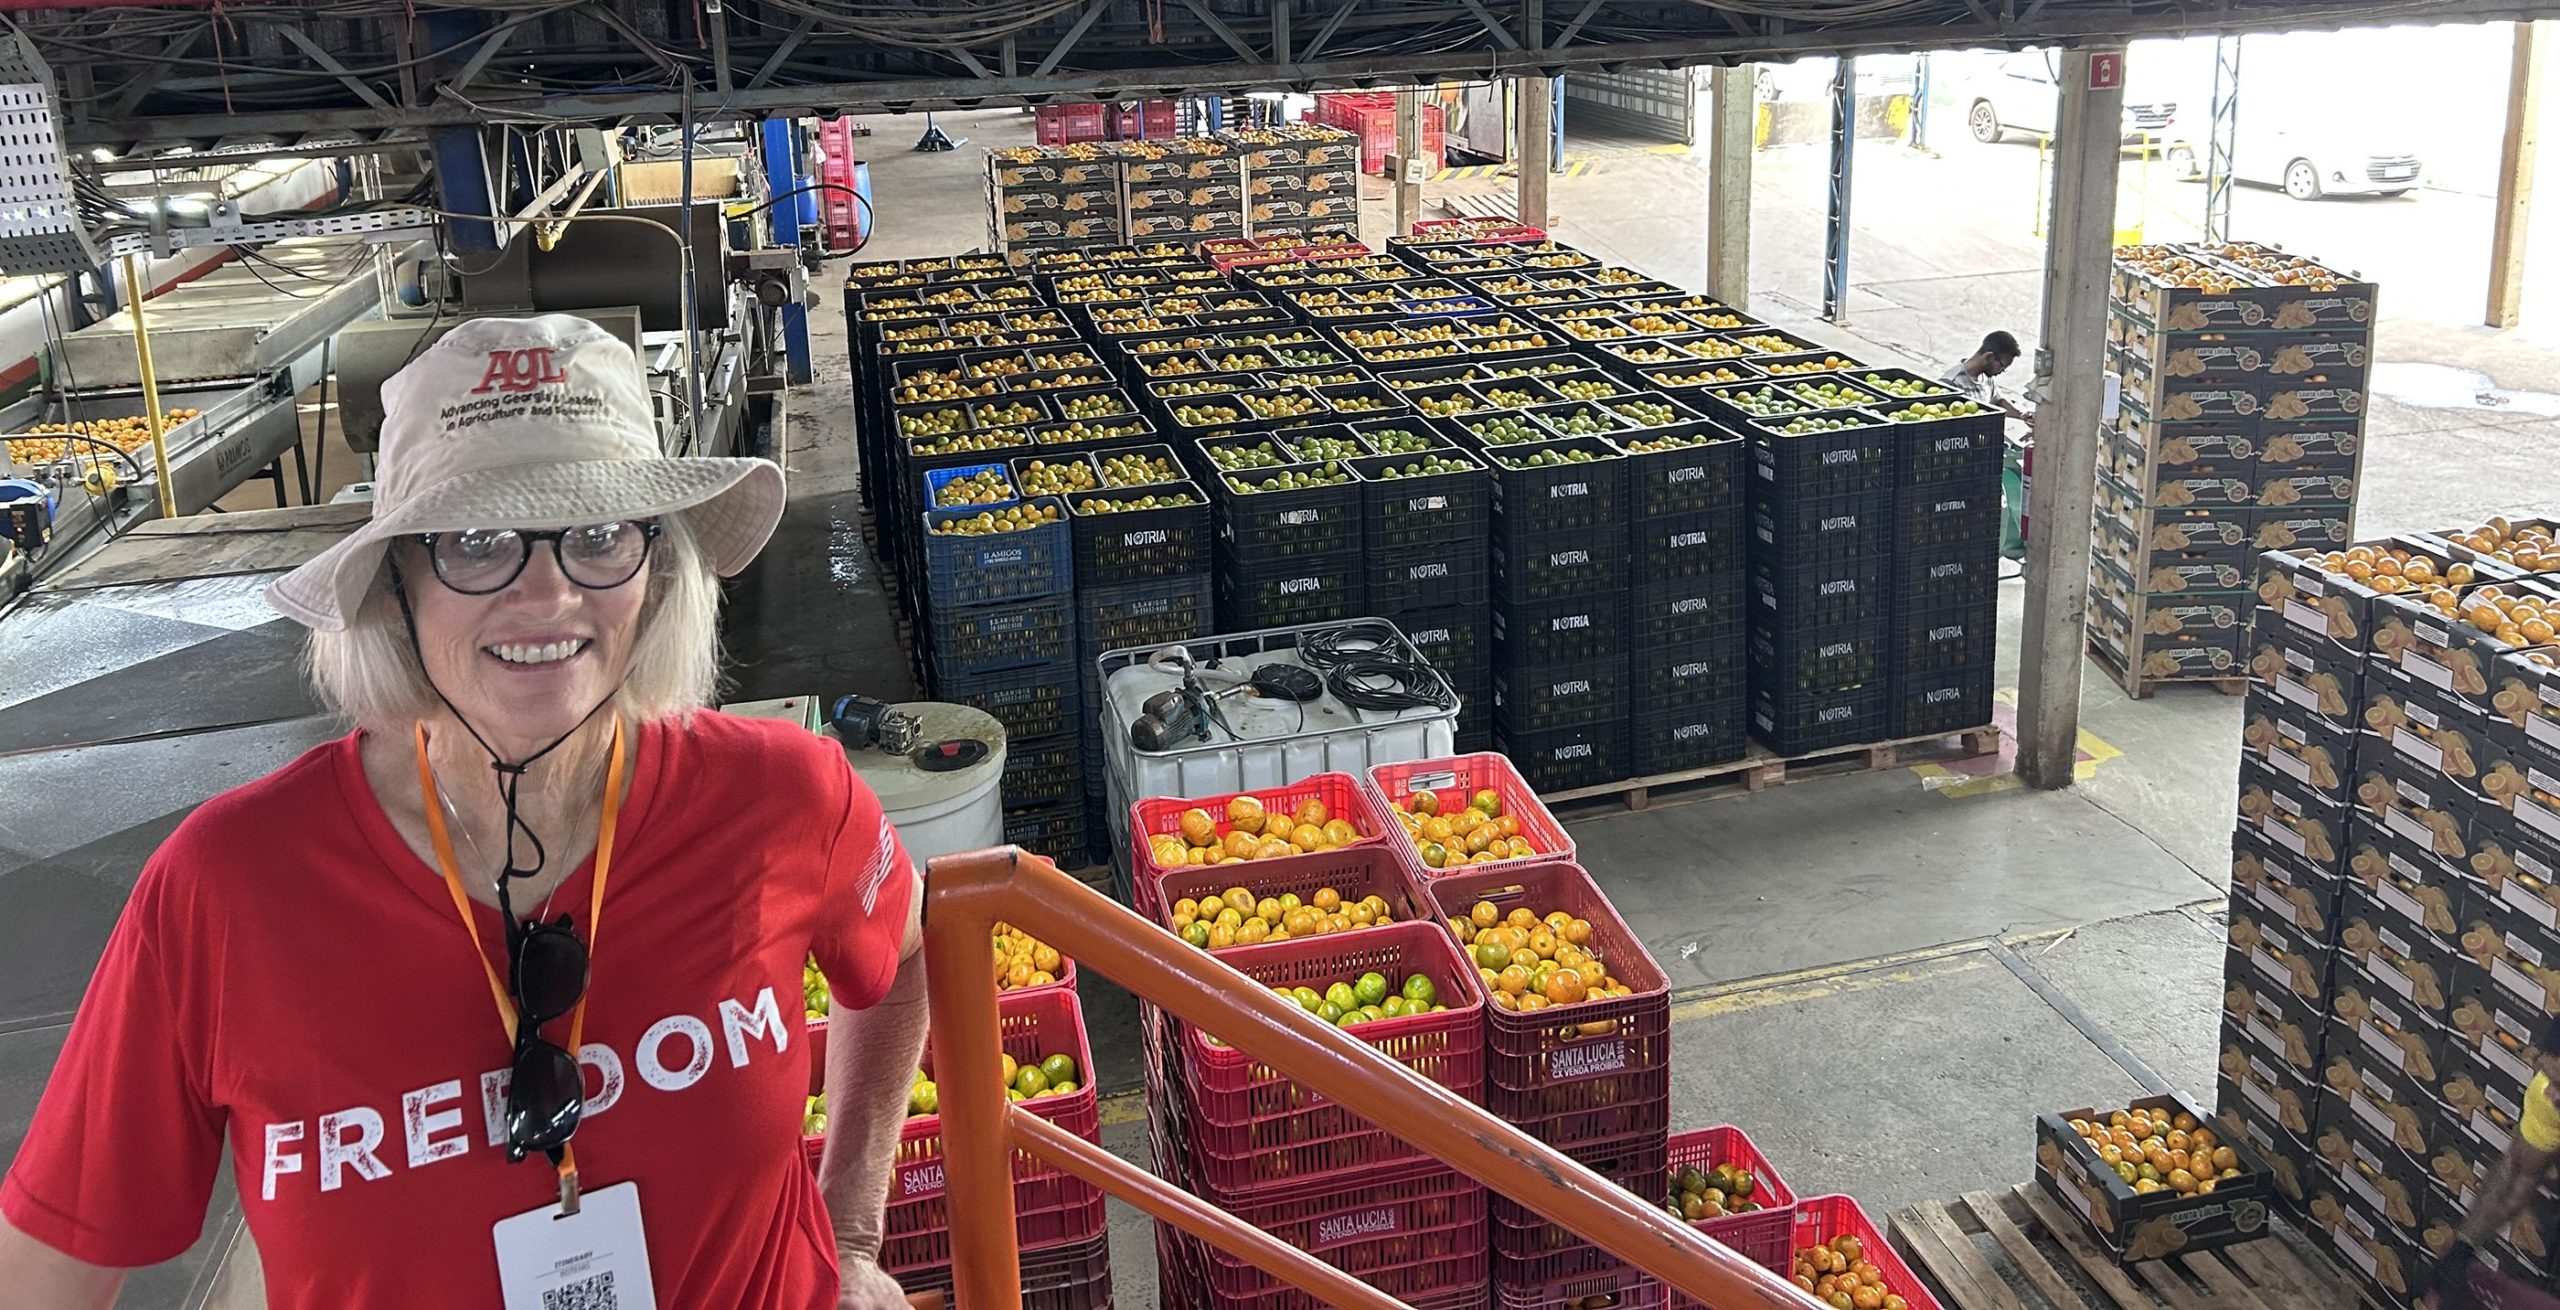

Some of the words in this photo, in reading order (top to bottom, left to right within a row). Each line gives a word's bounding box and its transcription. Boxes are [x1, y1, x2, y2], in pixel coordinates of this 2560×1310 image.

[440, 398, 499, 420] Advancing
[446, 420, 455, 431] in
[458, 407, 525, 428] Agriculture
[530, 406, 552, 416] and
[1935, 437, 1969, 452] NOTRIA
[1822, 449, 1857, 465] NOTRIA
[1668, 466, 1704, 483] NOTRIA
[1551, 482, 1588, 498] NOTRIA
[1935, 500, 1966, 511] NOTRIA
[1280, 509, 1318, 524] NTRIA
[1821, 515, 1855, 531] NOTRIA
[1125, 530, 1166, 546] NOTRIA
[1671, 532, 1706, 548] NOTRIA
[990, 549, 1022, 558] AMIGOS
[1551, 550, 1588, 566] NOTRIA
[1410, 563, 1448, 579] NOTRIA
[1930, 563, 1963, 579] NOTRIA
[1281, 576, 1320, 594] NOTRIA
[1820, 579, 1855, 595] NOTRIA
[1672, 598, 1707, 614] NOTRIA
[1553, 615, 1589, 631] NOTRIA
[1411, 628, 1450, 645] NOTRIA
[1929, 625, 1962, 642] NOTRIA
[1820, 642, 1852, 658] NOTRIA
[1672, 662, 1708, 678] NOTRIA
[1553, 680, 1590, 696] NOTRIA
[1927, 687, 1960, 704] NOTRIA
[1819, 706, 1852, 722] NOTRIA
[1673, 723, 1708, 740] NOTRIA
[1555, 743, 1592, 760] NOTRIA
[1552, 1048, 1584, 1069] SANTA
[1586, 1042, 1616, 1063] LUCIA
[1564, 1066, 1590, 1076] VENDA
[1590, 1060, 1625, 1072] PROIBIDA
[904, 1165, 944, 1188] SANTA
[919, 1180, 945, 1191] VEND
[1320, 1215, 1355, 1236] SANTA
[1356, 1209, 1388, 1228] LUCIA
[2172, 1209, 2198, 1222] SANTA
